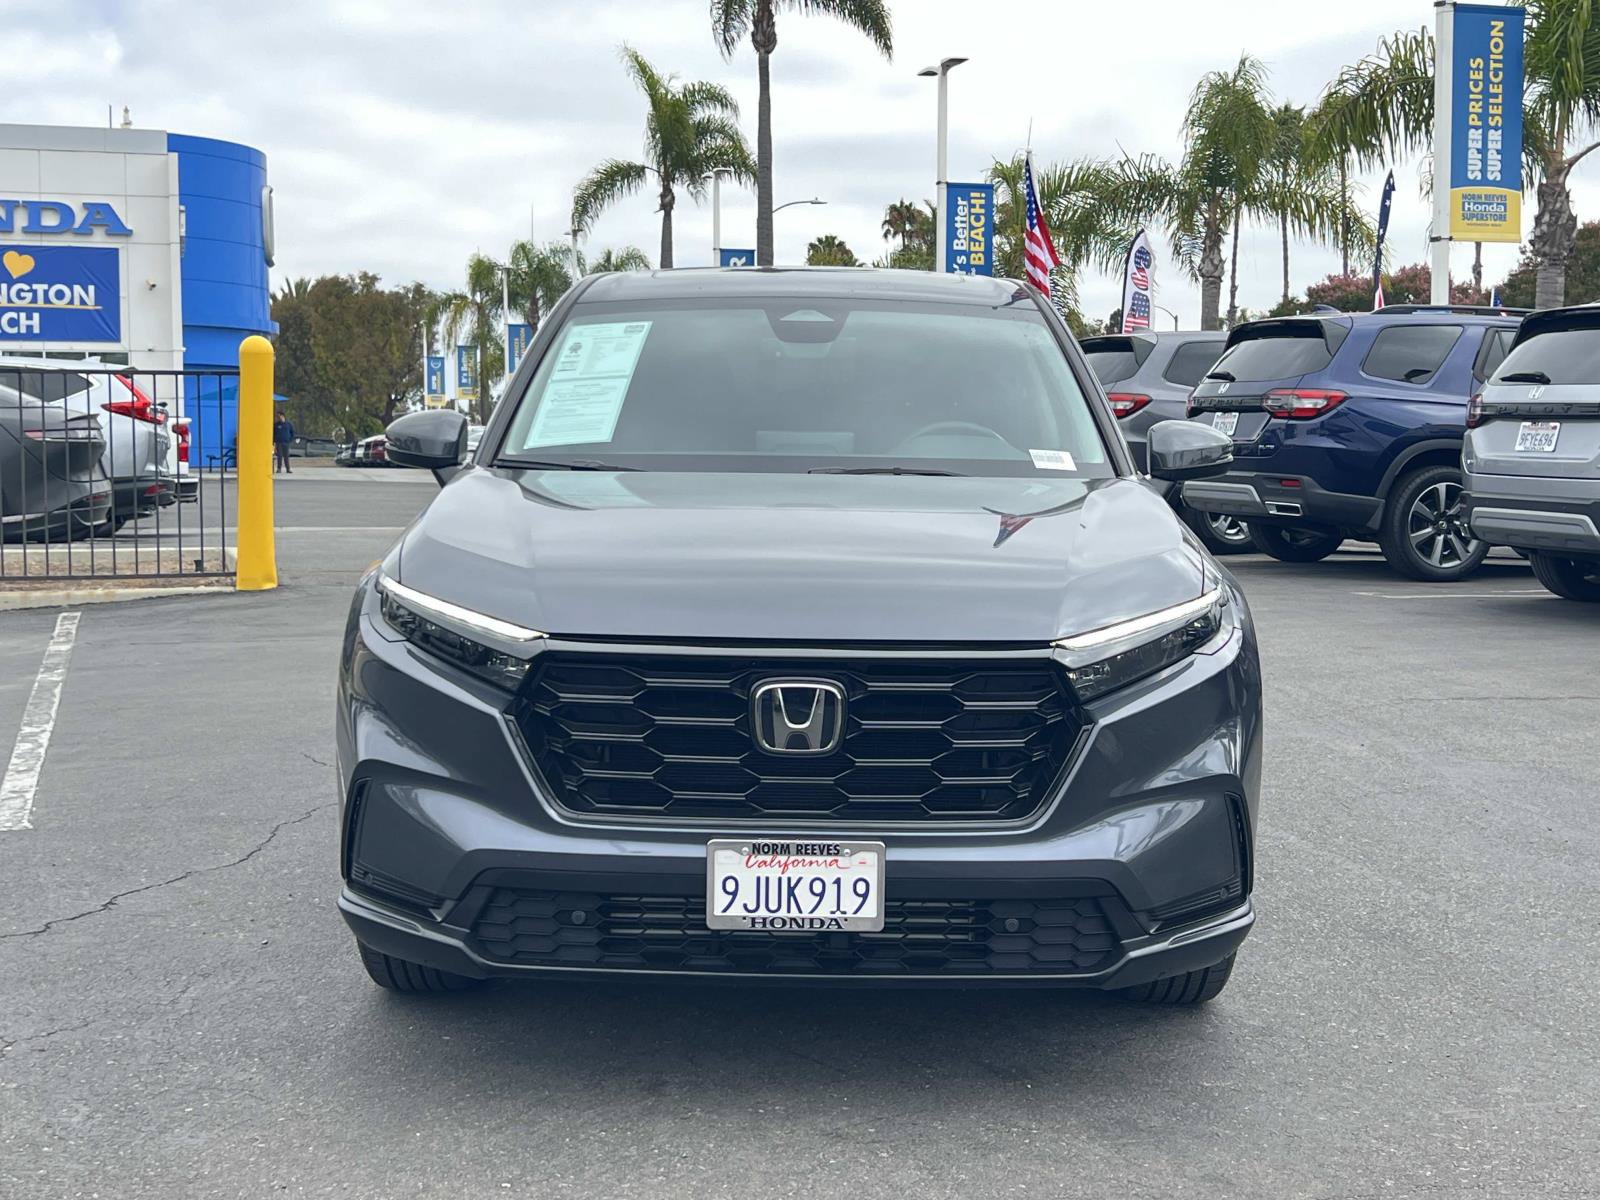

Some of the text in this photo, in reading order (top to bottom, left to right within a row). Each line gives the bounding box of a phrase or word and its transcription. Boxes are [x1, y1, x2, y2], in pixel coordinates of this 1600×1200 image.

[1487, 20, 1504, 181] SUPER SELECTION
[1467, 57, 1484, 180] SUPER PRICES
[1464, 202, 1505, 211] Honda
[1484, 194, 1507, 202] REEVES
[953, 197, 968, 251] Better
[1462, 213, 1507, 221] SUPERSTORE
[970, 192, 985, 265] BEACH!
[0, 312, 40, 334] CH
[752, 842, 840, 856] NORM REEVES
[745, 854, 850, 874] California
[721, 875, 871, 915] 9JUK919
[749, 917, 845, 929] HONDA
